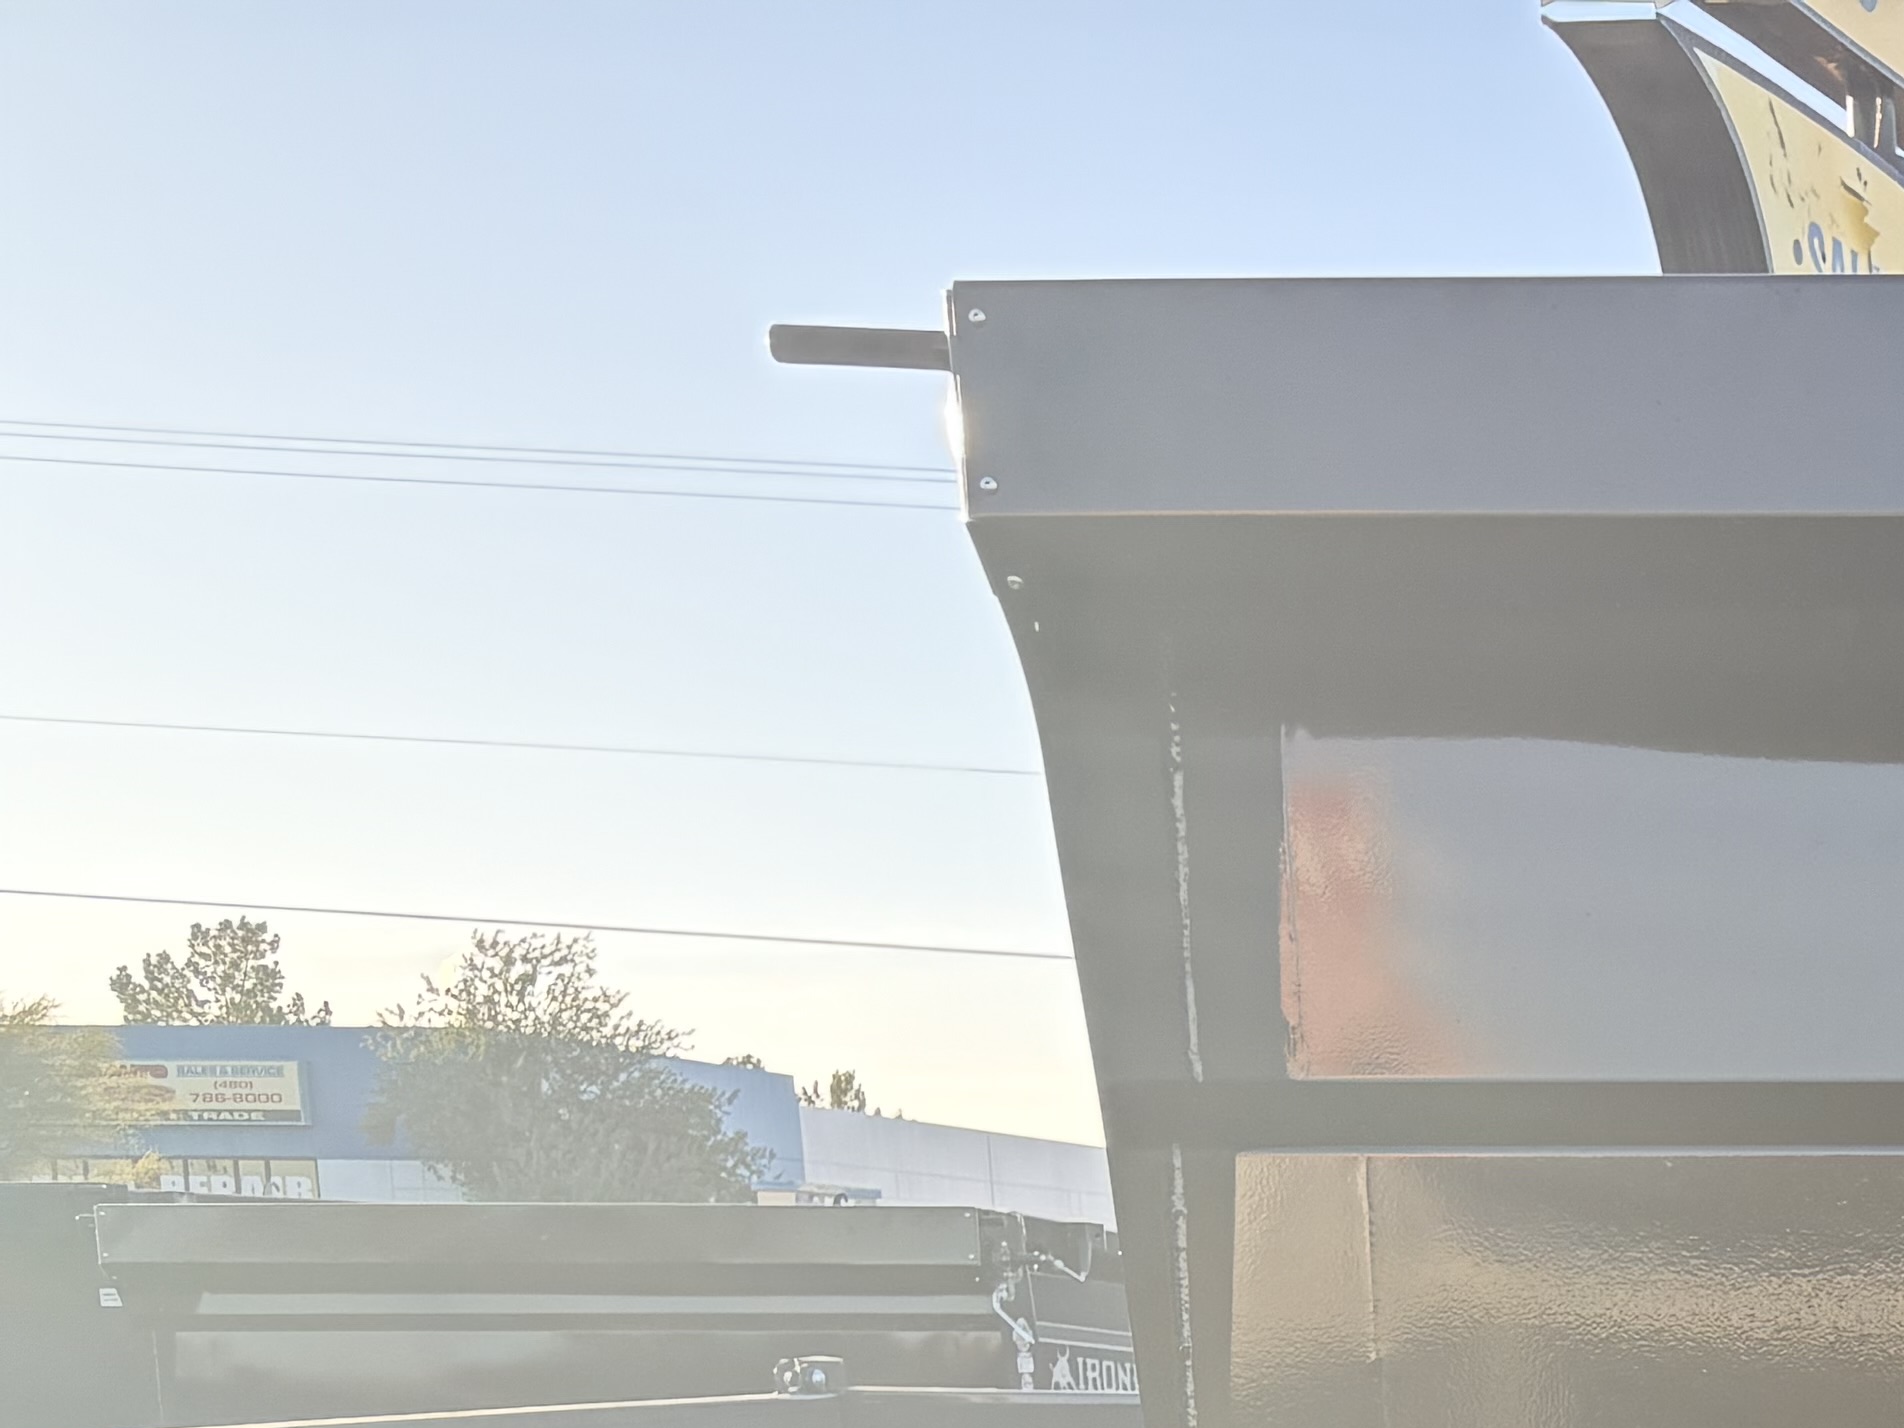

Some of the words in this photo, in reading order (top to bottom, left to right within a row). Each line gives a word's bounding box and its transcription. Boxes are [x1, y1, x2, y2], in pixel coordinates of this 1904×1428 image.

[231, 1065, 285, 1077] SERVICE
[213, 1080, 254, 1090] (480)
[189, 1092, 283, 1103] 786-8000
[188, 1110, 266, 1121] TRADE
